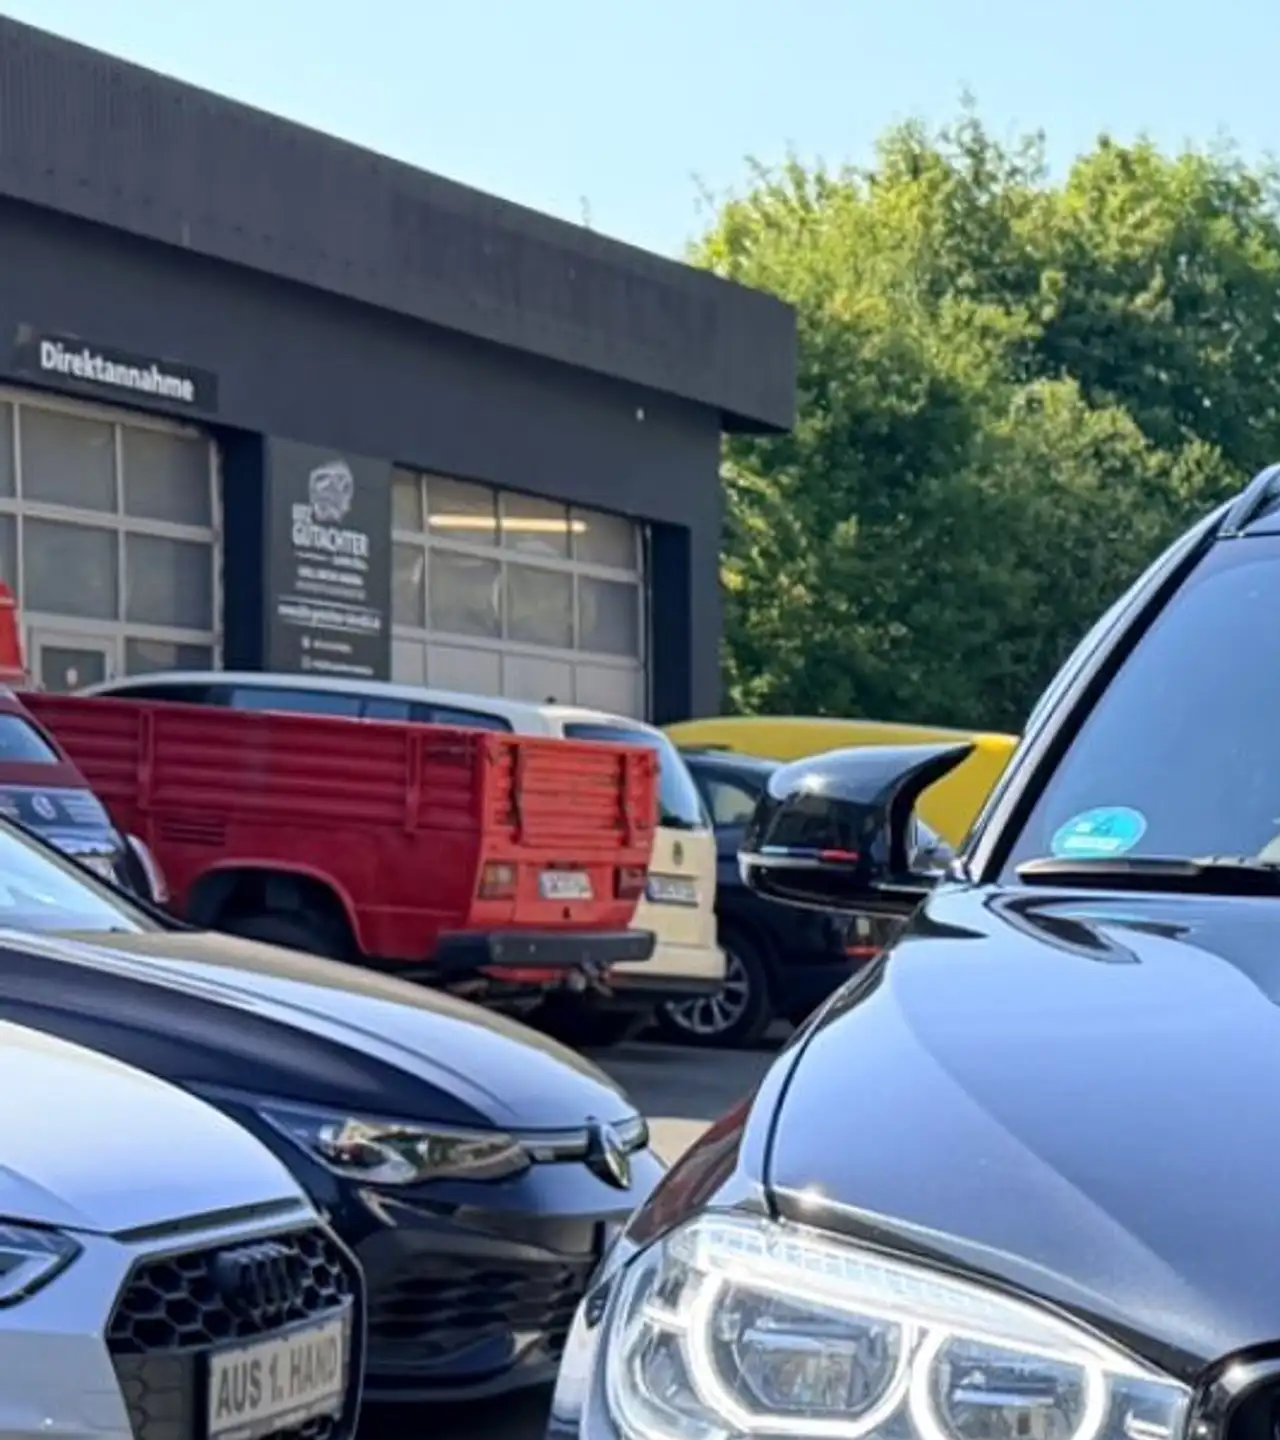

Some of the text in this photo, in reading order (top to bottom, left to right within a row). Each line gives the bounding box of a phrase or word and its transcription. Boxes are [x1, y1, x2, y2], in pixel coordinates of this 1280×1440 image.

[40, 340, 195, 402] Direktannahme
[216, 1334, 338, 1420] AUS 1. HAND
